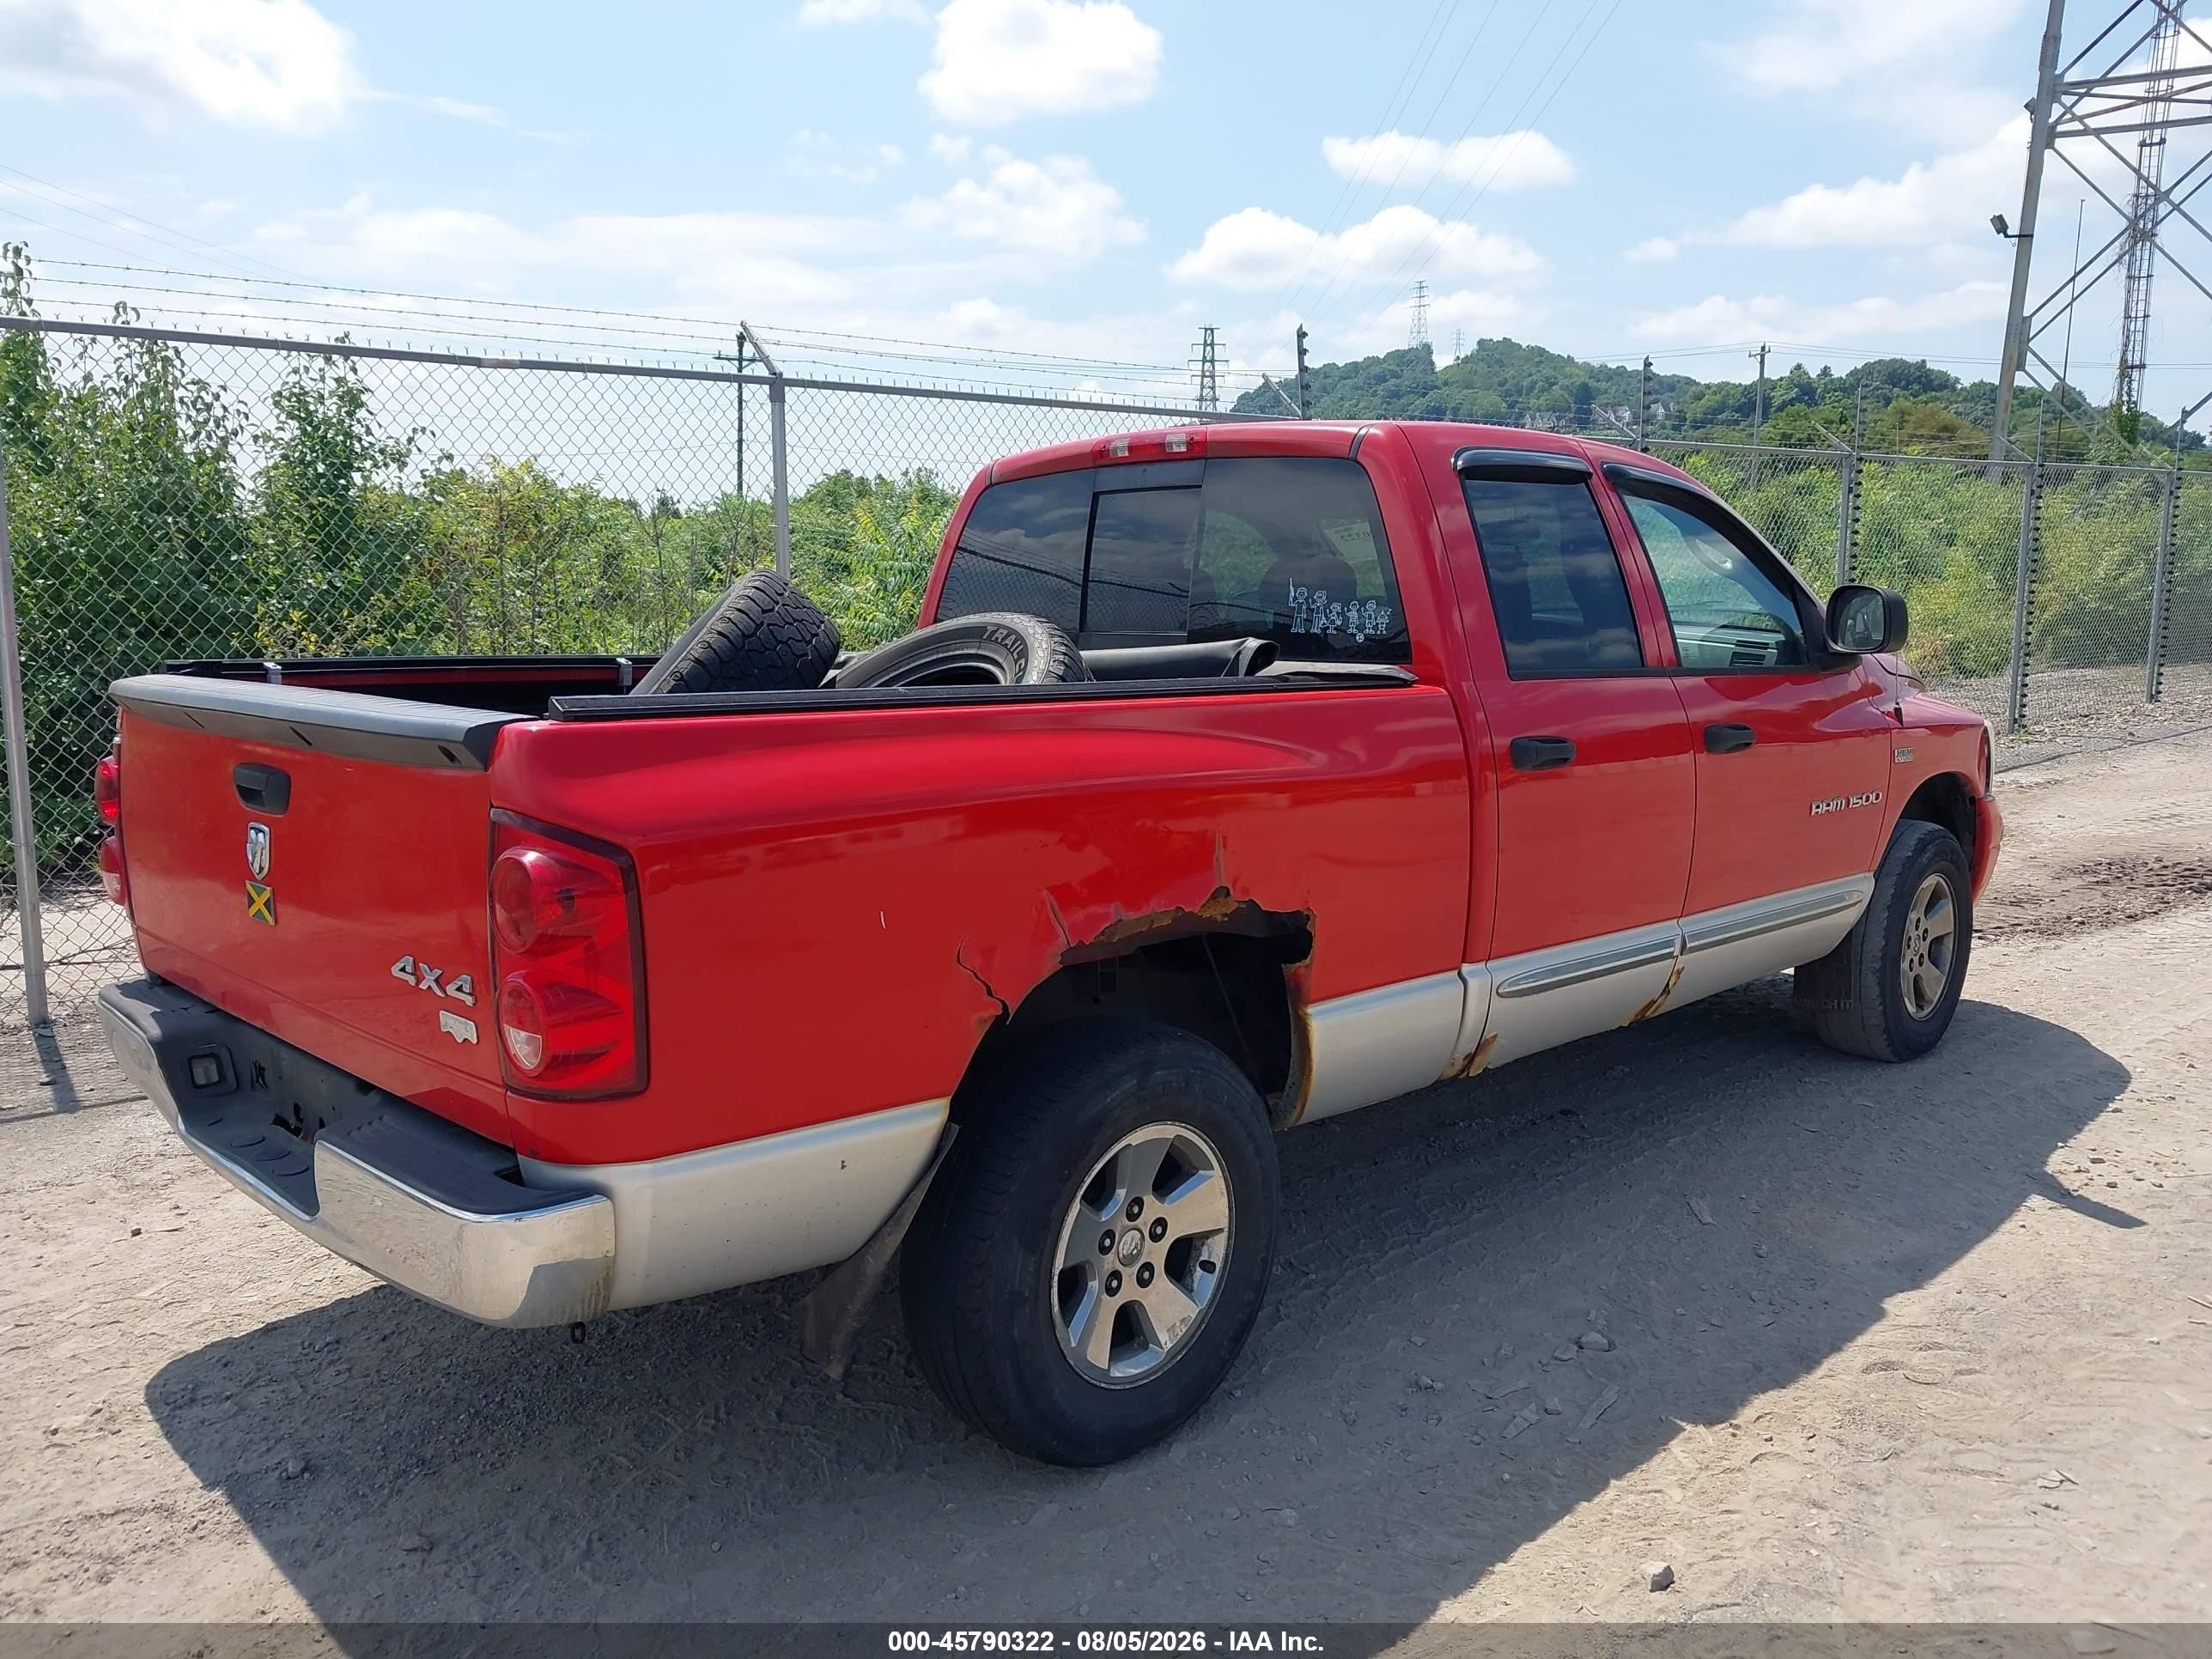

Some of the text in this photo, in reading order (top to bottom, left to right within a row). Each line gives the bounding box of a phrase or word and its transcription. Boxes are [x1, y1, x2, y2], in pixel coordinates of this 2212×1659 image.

[1811, 789, 1882, 816] RAM 1500
[391, 955, 476, 1006] 4X4
